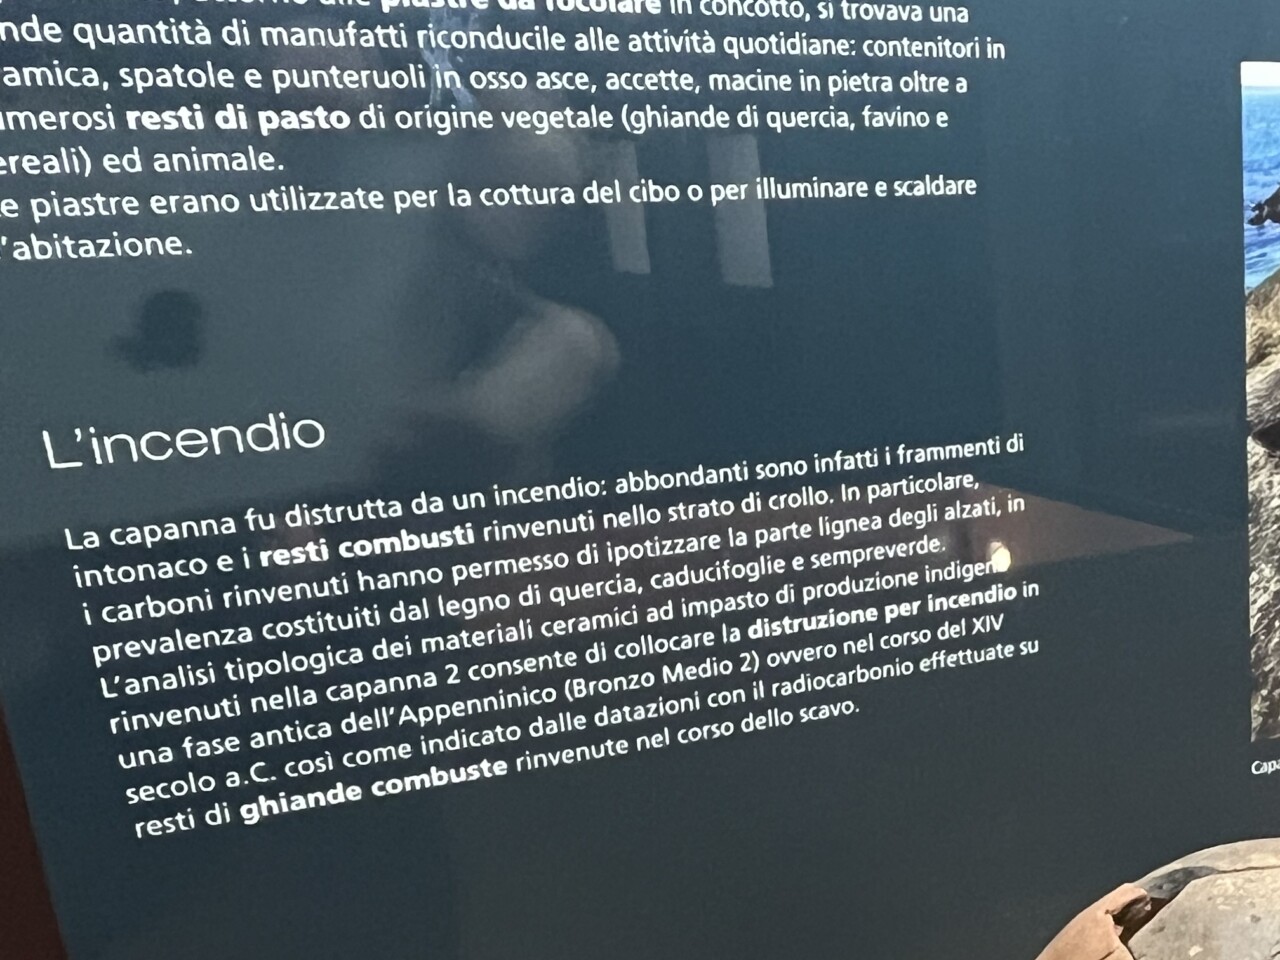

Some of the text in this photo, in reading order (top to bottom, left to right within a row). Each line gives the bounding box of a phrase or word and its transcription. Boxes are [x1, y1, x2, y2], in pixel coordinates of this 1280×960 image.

[72, 17, 212, 51] quantità
[221, 17, 251, 47] di
[260, 19, 408, 49] manufatti
[416, 23, 567, 52] riconducile
[574, 26, 620, 52] alle
[628, 28, 716, 54] attività
[722, 31, 857, 60] quotidiane:
[862, 35, 980, 59] contenitori
[986, 36, 1006, 60] in
[699, 0, 811, 23] concotto,
[816, 1, 834, 20] si
[839, 0, 923, 22] trovava
[929, 5, 969, 24] una
[125, 103, 205, 131] resti
[214, 102, 249, 130] di
[257, 105, 351, 137] pasto
[358, 102, 386, 130] di
[394, 104, 494, 136] origine
[500, 104, 614, 136] vegetale
[621, 103, 731, 135] (ghiande
[736, 104, 759, 128] di
[766, 105, 856, 134] quercia,
[861, 104, 931, 128] favino
[935, 111, 949, 128] e
[102, 145, 143, 174] ed
[153, 144, 284, 173] animale.
[0, 230, 193, 261] 'abitazione.
[41, 411, 326, 469] L'incendio
[64, 432, 1025, 551] La capanna fu distrutta da un incendio: abbondanti sono infatti i frammenti di
[92, 534, 946, 669] prevalenza costituiti dal legno di quercia, caducifoglie e sempreverde.
[99, 559, 1007, 699] L'analisi tipologica dei materiali ceramici ad impasto di produzione indigen
[117, 612, 1005, 770] una fase antica dell'Appenninico (Bronzo Medio 2) ovvero nel corso del XIV
[134, 700, 860, 839] resti di ghiande combuste rinvenute nel corso dello scavo.
